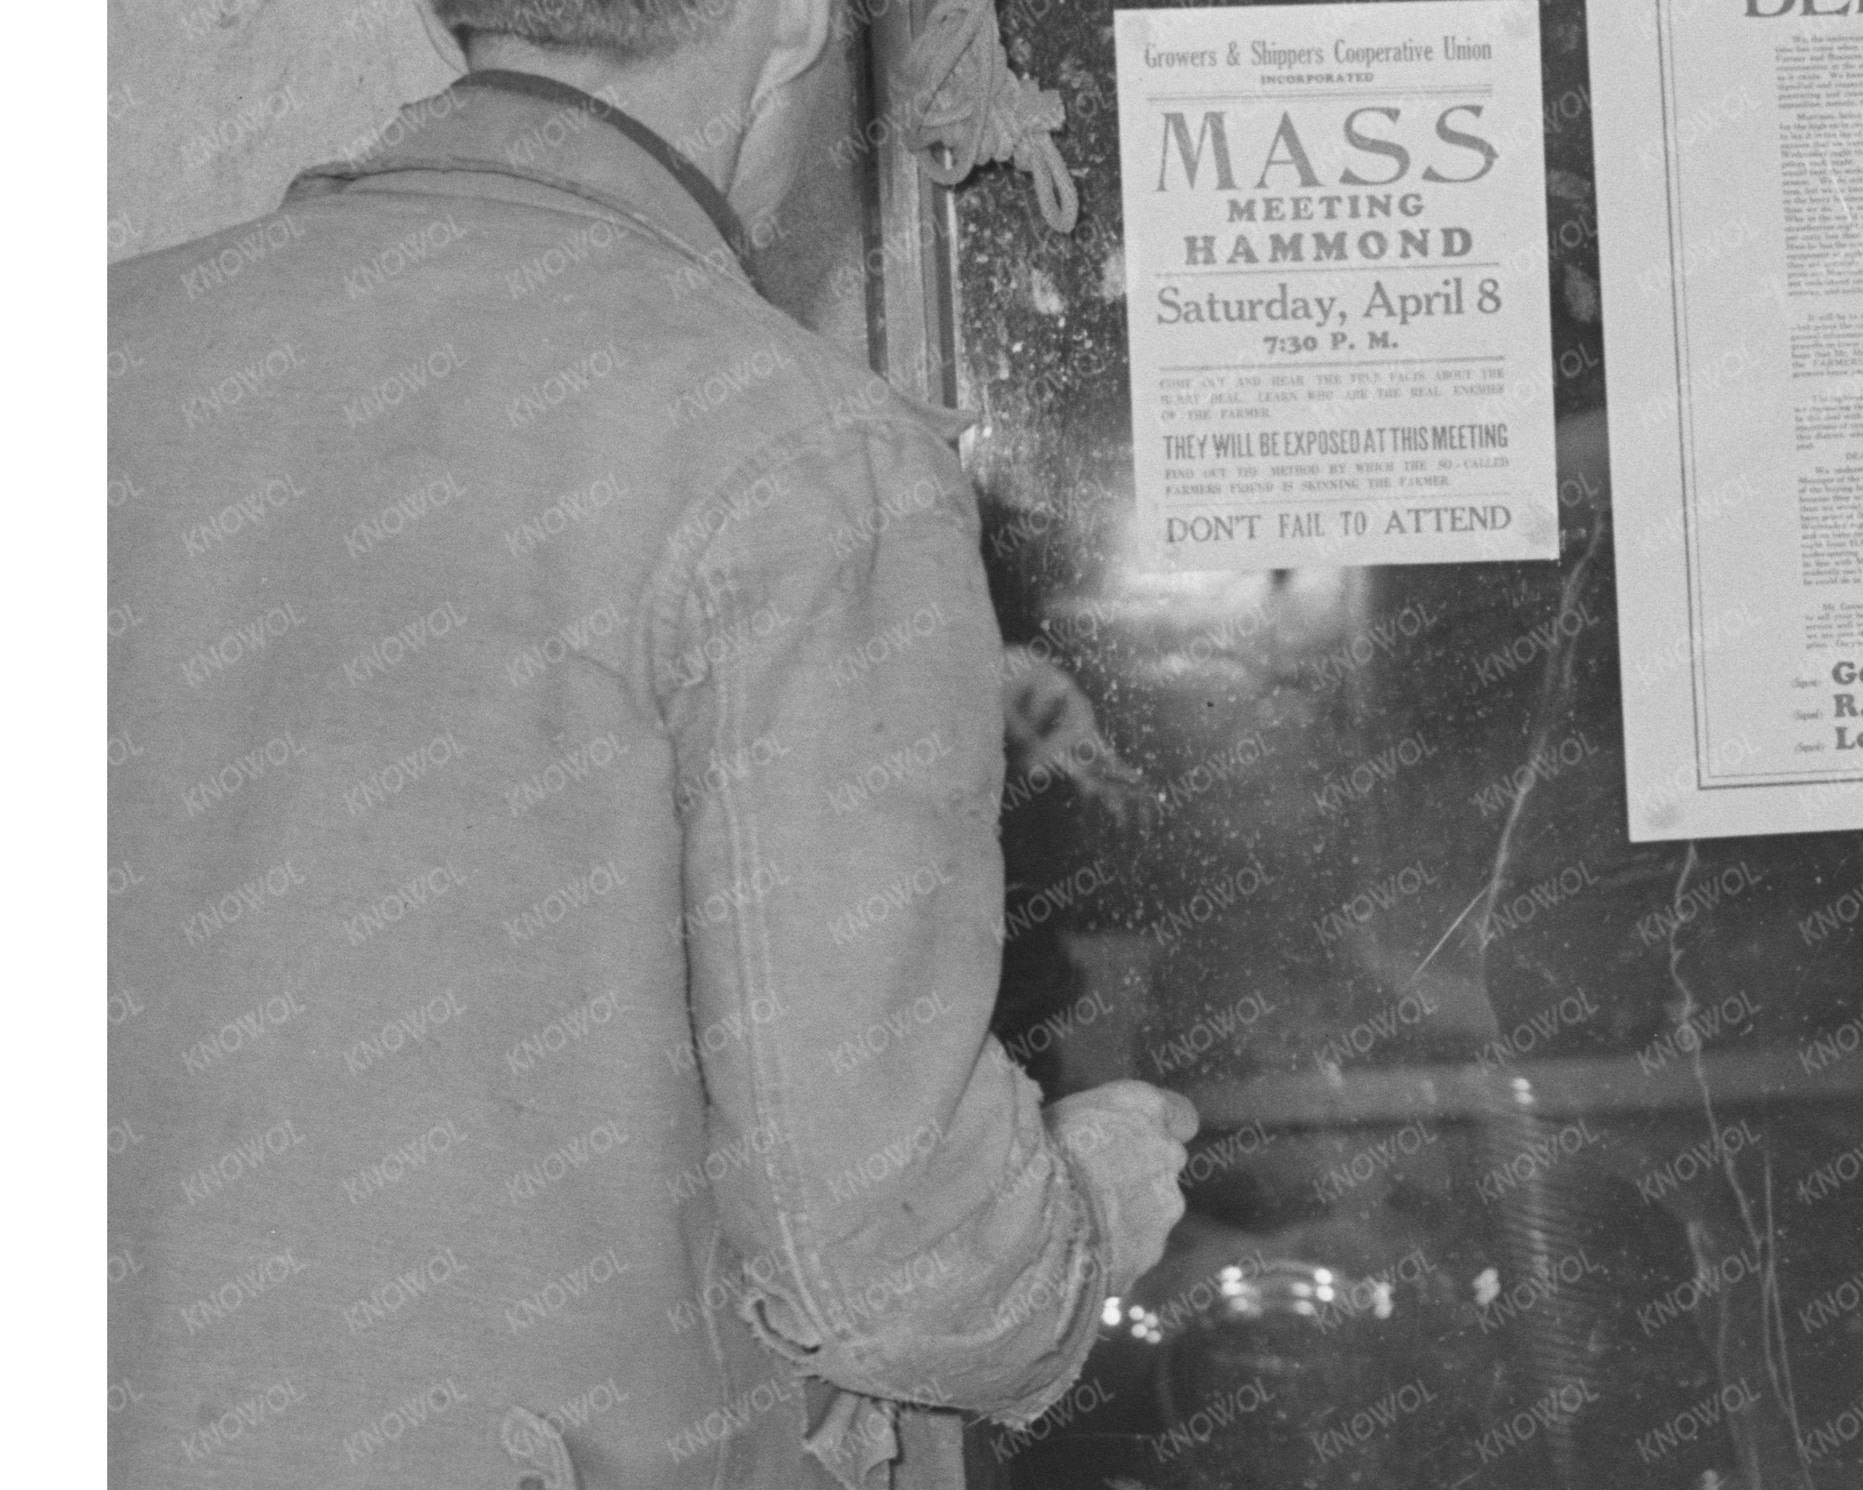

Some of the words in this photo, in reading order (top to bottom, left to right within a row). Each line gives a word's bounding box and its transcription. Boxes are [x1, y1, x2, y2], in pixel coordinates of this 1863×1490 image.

[1144, 43, 1217, 68] Growers
[1226, 41, 1241, 66] &
[1251, 40, 1325, 70] Shippers
[1334, 39, 1433, 68] Cooperative
[1443, 35, 1492, 61] Union
[1261, 72, 1374, 86] INCORPORATED
[1156, 104, 1500, 192] MASS
[1227, 193, 1425, 223] MEETING
[1183, 227, 1473, 265] HAMMOND
[1157, 282, 1348, 328] Saturday,
[1362, 277, 1465, 326] April
[1476, 278, 1501, 315] 8
[1263, 335, 1318, 355] 7:30
[1330, 332, 1355, 351] P.
[1368, 330, 1399, 349] M.
[1163, 434, 1207, 460] THEY
[1212, 432, 1254, 458] WILL
[1259, 431, 1281, 457] BE
[1284, 429, 1360, 457] EXPOSED
[1364, 427, 1386, 453] AT
[1389, 426, 1429, 452] THIS
[1432, 423, 1508, 450] MEETING
[1166, 514, 1262, 544] DON'T
[1278, 512, 1325, 539] FAIL
[1340, 510, 1367, 536] TO
[1384, 504, 1512, 535] ATTEND
